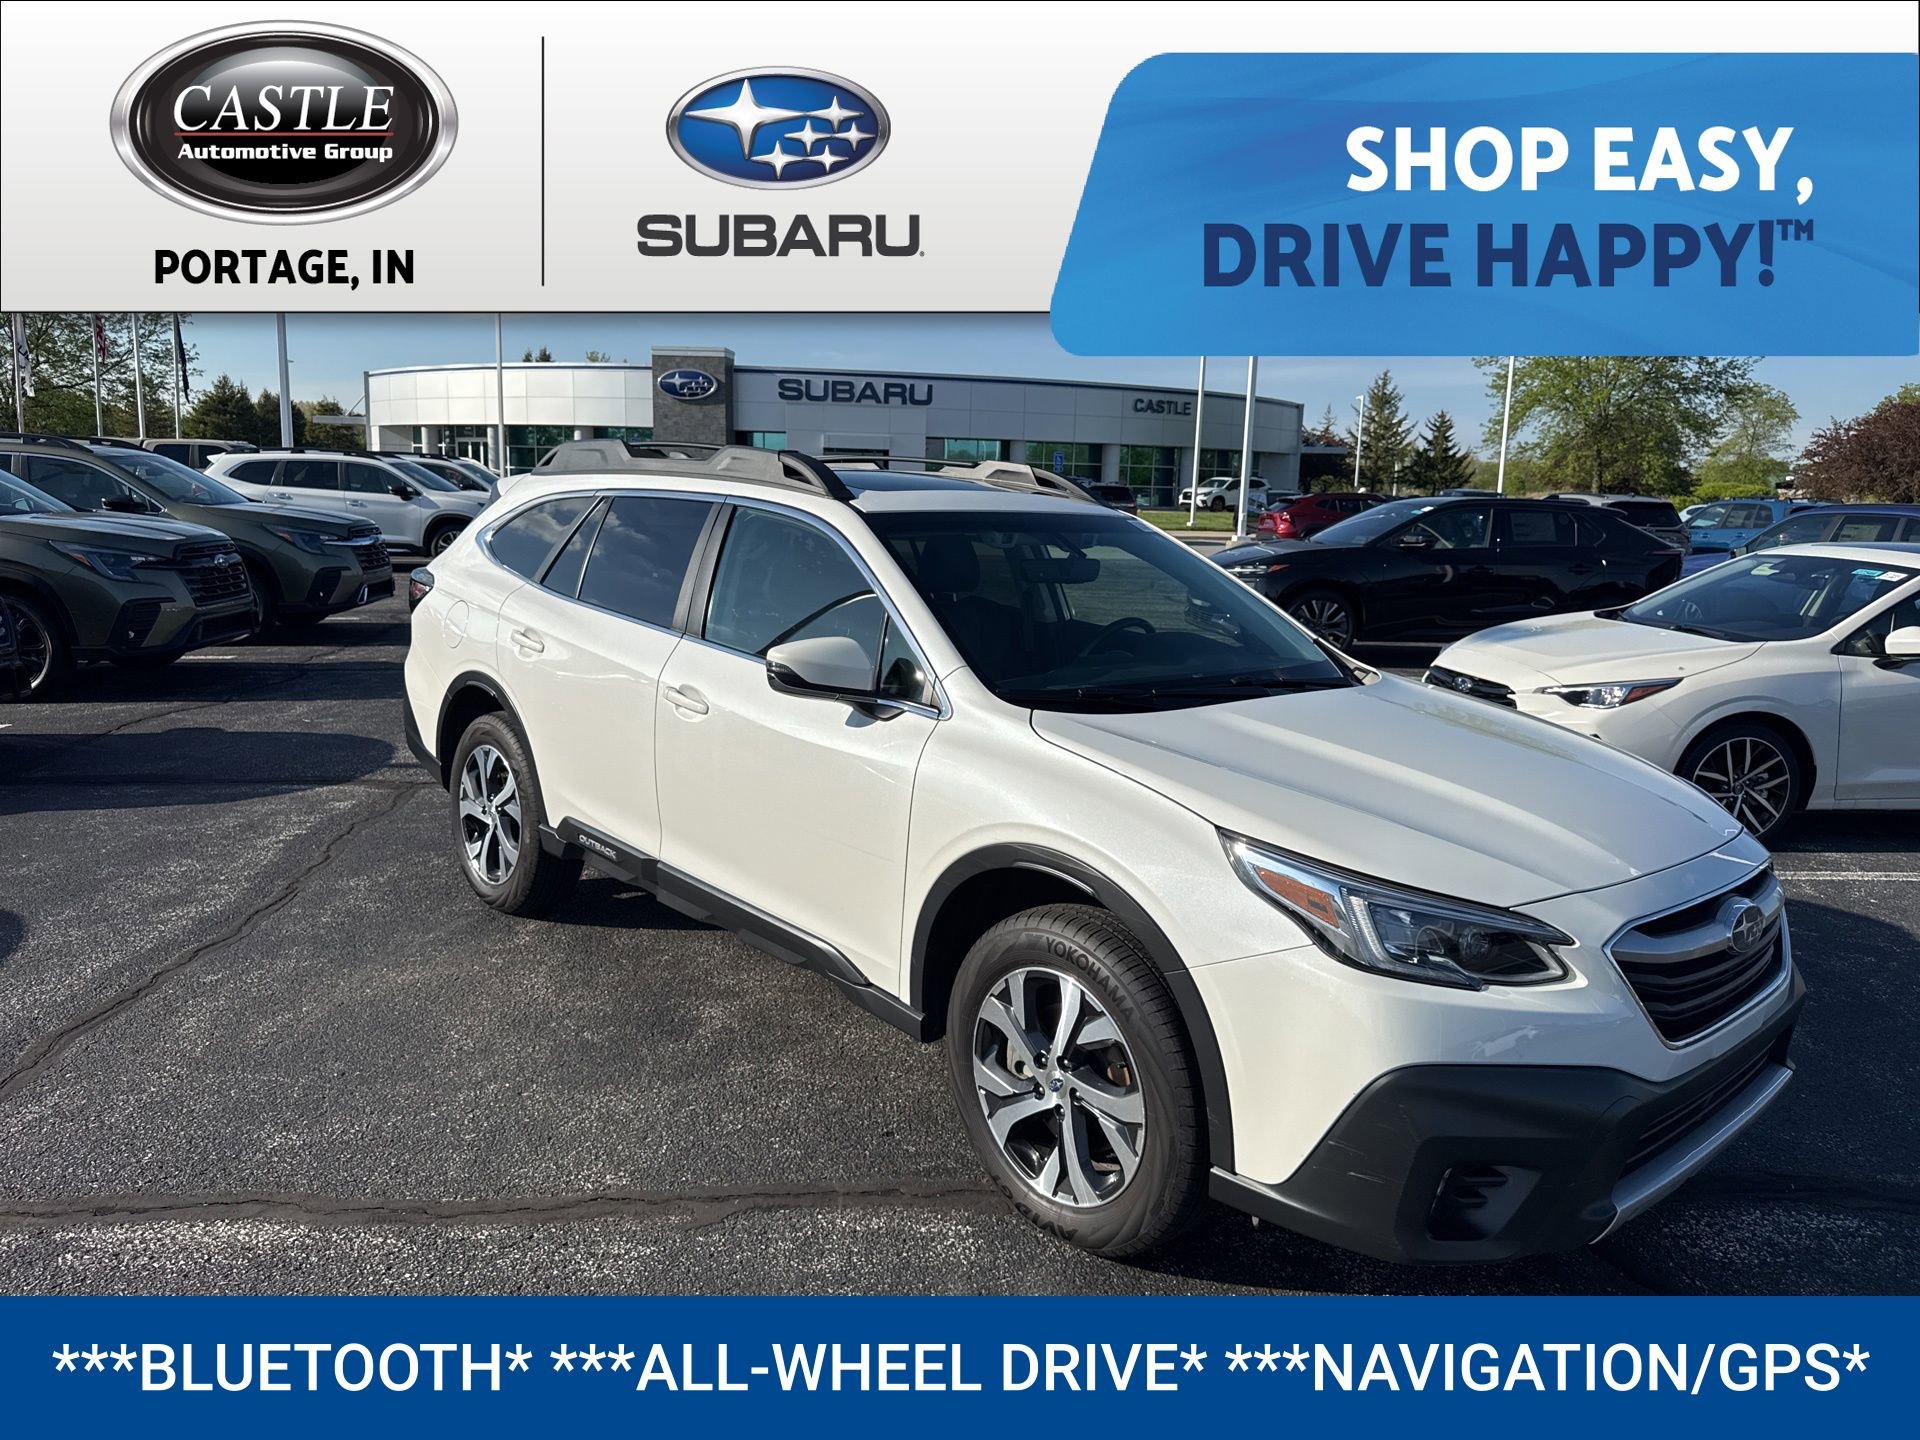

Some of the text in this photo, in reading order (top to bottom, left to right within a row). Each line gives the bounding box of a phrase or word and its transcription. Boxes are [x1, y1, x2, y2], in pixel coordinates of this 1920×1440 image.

[778, 378, 933, 406] SUBARU
[1133, 398, 1192, 416] CASTLE
[579, 834, 617, 860] OUTBACK
[1045, 936, 1135, 1021] YOKOHAMA
